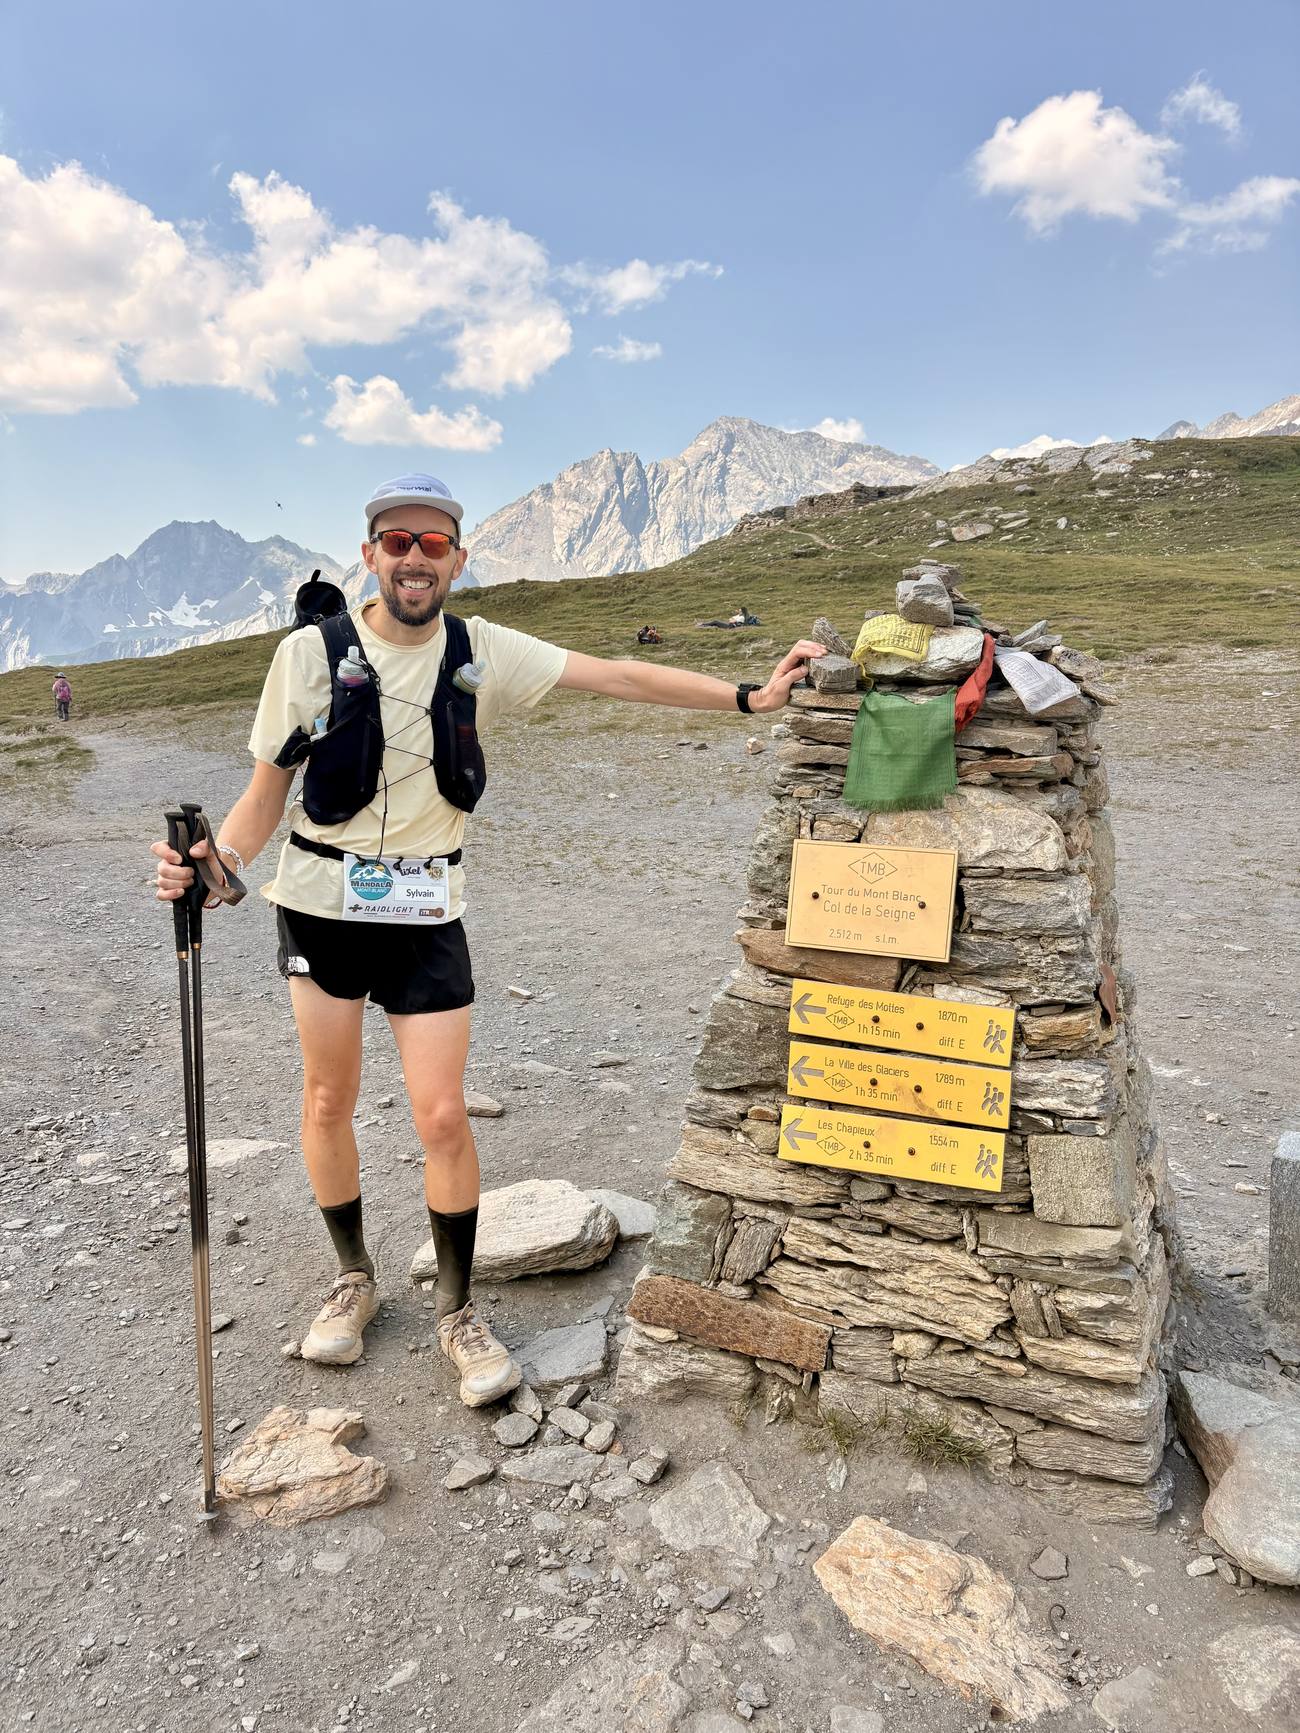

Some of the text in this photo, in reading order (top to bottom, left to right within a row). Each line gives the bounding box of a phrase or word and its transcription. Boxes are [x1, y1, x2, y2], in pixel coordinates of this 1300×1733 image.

[860, 861, 885, 875] TMB
[406, 889, 435, 899] Sylvain
[822, 884, 921, 902] Tour du Mont Blanc
[823, 900, 916, 921] Col de la Seigne
[853, 932, 862, 941] m
[827, 994, 905, 1014] Refuge des Mottes
[833, 1015, 848, 1025] TMB
[958, 1015, 968, 1024] m
[958, 1038, 966, 1049] E
[824, 1057, 910, 1078] La Ville des Glaciers
[831, 1078, 846, 1088] TMB
[955, 1077, 965, 1087] m
[957, 1101, 963, 1112] E
[817, 1119, 875, 1136] Les Chapieux
[824, 1141, 839, 1151] TMB
[949, 1139, 959, 1149] m
[863, 1151, 874, 1162] 35
[875, 1155, 893, 1165] min
[950, 1164, 957, 1175] E
